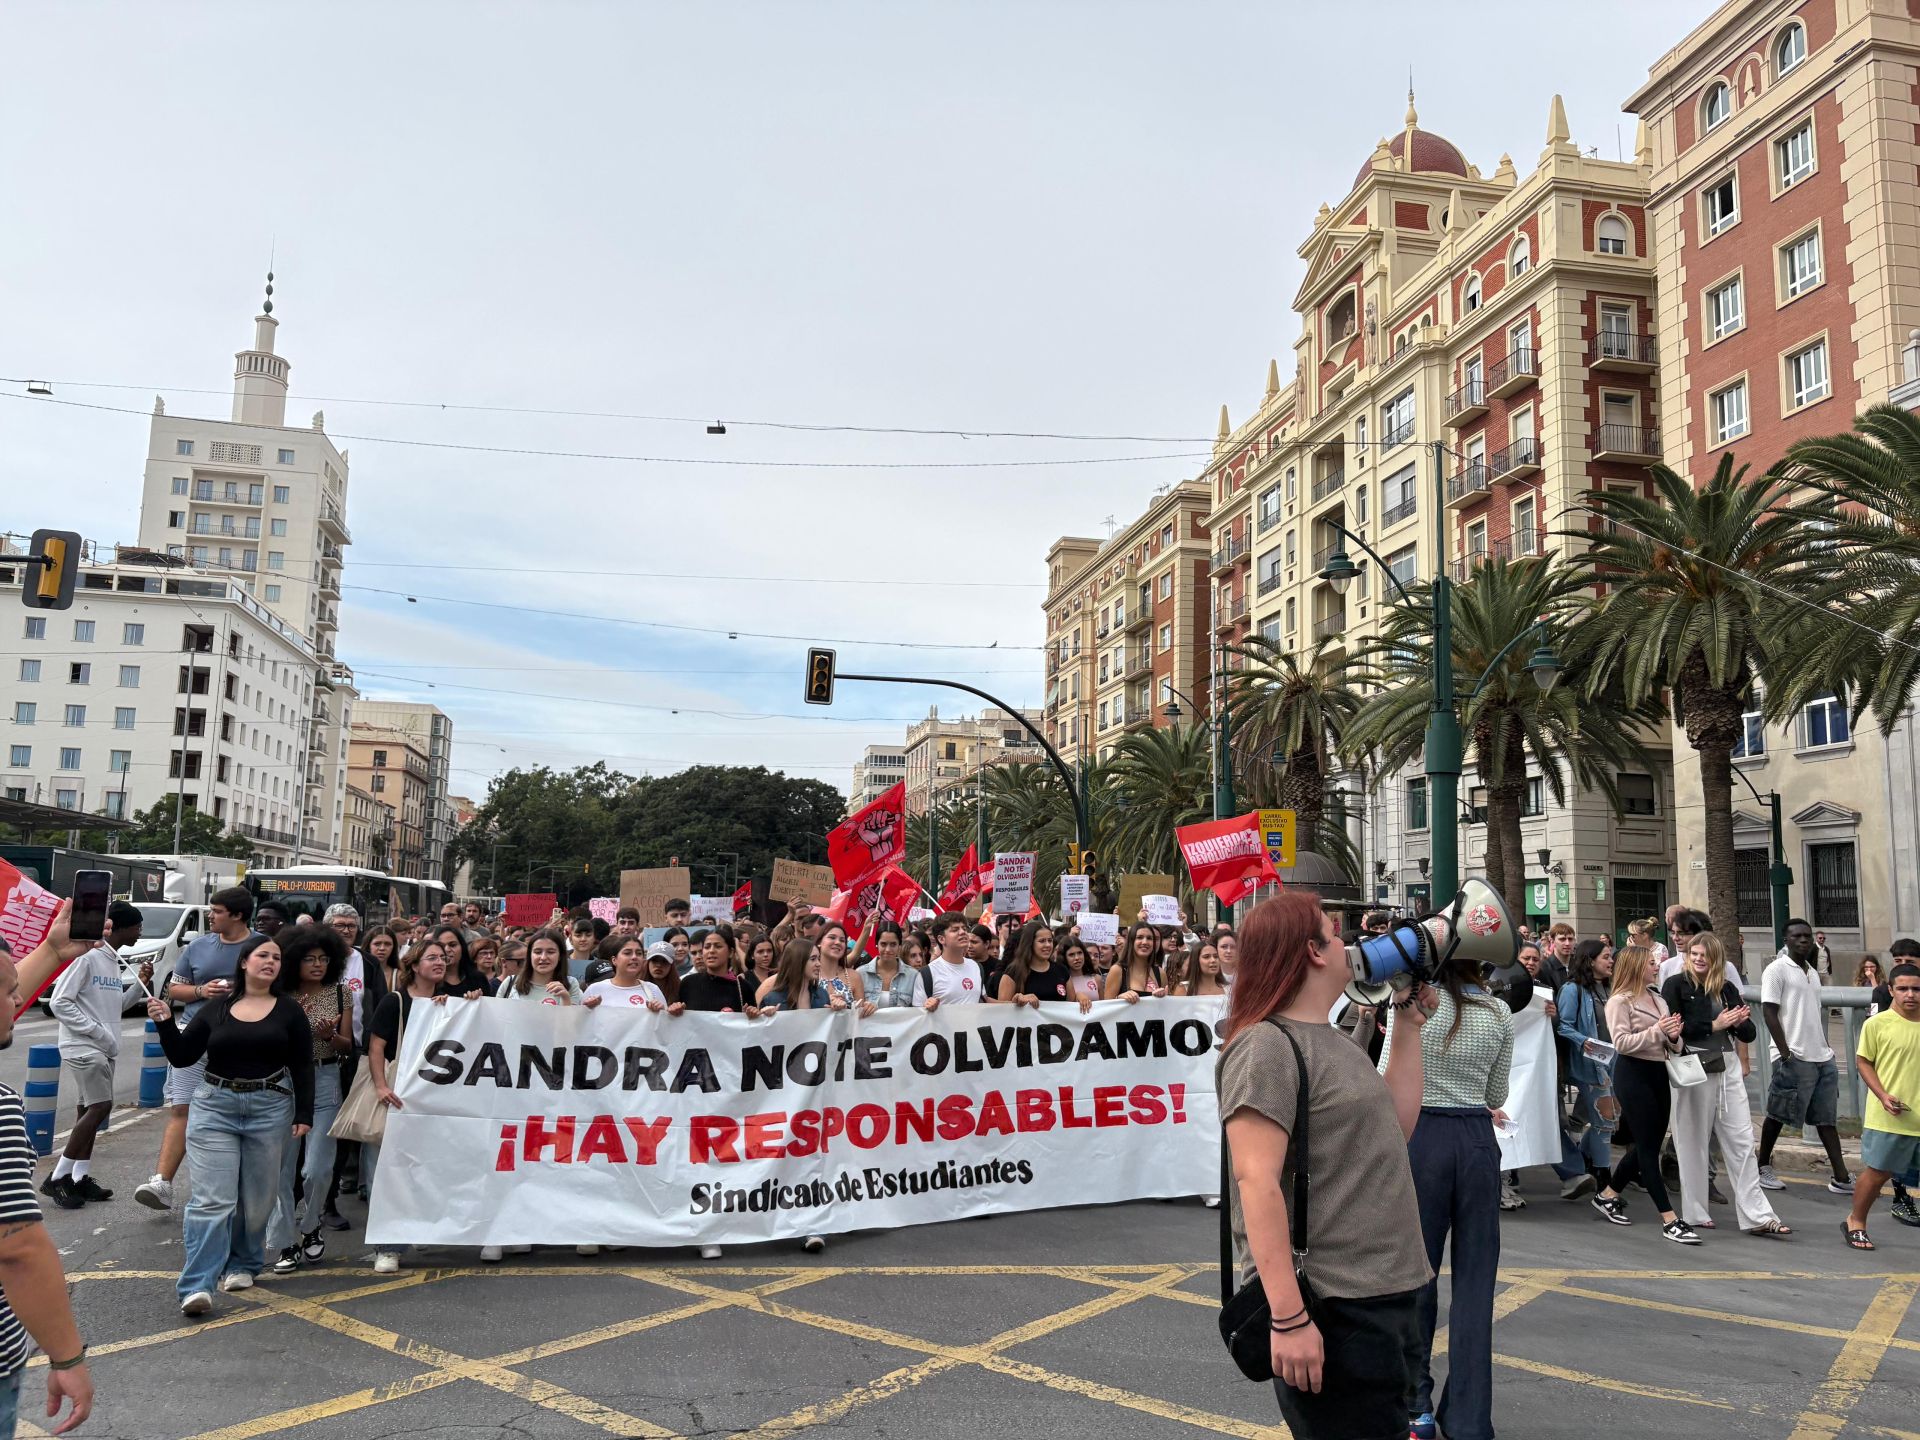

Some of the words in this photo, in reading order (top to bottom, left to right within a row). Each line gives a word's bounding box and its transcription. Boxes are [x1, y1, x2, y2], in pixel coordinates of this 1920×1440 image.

[1184, 831, 1250, 855] IZQUIERDA
[998, 857, 1031, 866] SANDRA
[997, 872, 1030, 880] OLVIDAMOS
[995, 885, 1029, 893] RESPONSABLES
[418, 1039, 721, 1094] SANDRA
[495, 1114, 673, 1172] ¡HAY
[689, 1082, 1187, 1166] RESPONSABLES!
[688, 1178, 835, 1215] Sindicato
[836, 1170, 863, 1203] de
[862, 1159, 1034, 1200] Estudiantes
